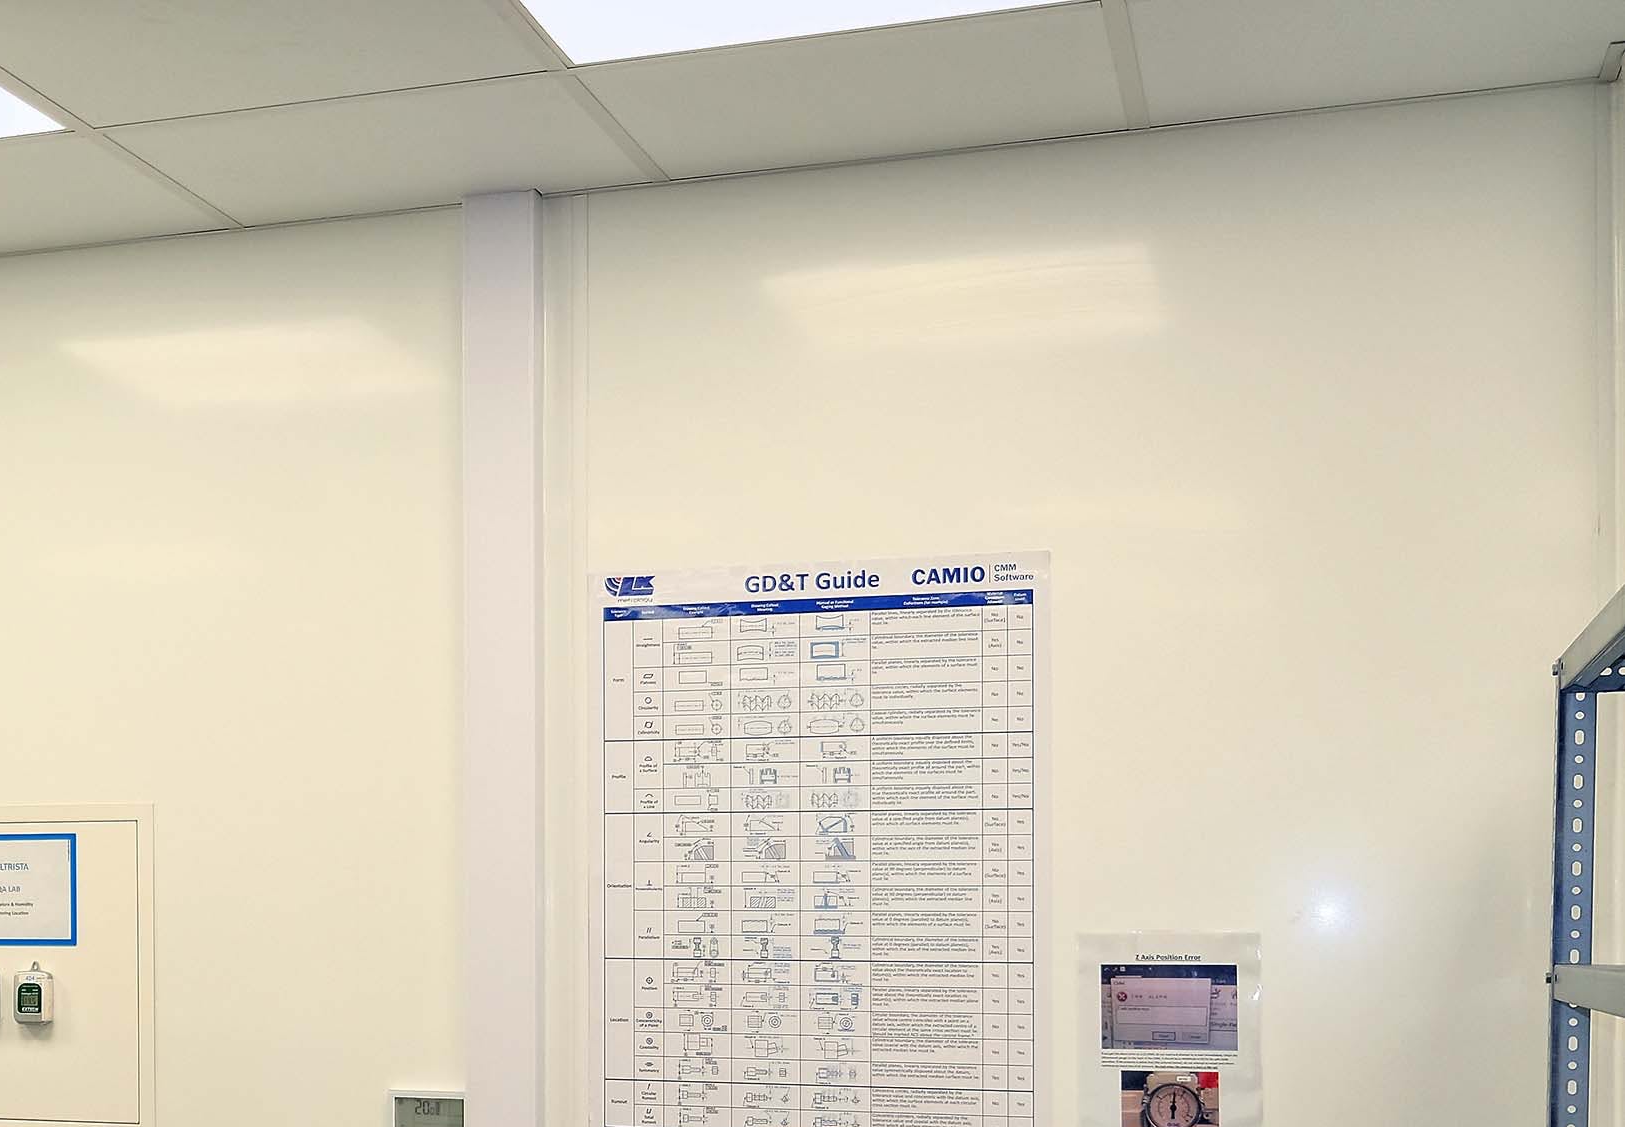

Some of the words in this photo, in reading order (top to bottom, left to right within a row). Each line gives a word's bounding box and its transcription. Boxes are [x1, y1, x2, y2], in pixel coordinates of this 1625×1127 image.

[912, 566, 986, 585] CAMIO
[994, 564, 1017, 572] CMM
[994, 572, 1034, 582] Software
[618, 576, 655, 596] LK
[744, 573, 810, 593] GD&T
[815, 569, 880, 590] Guide
